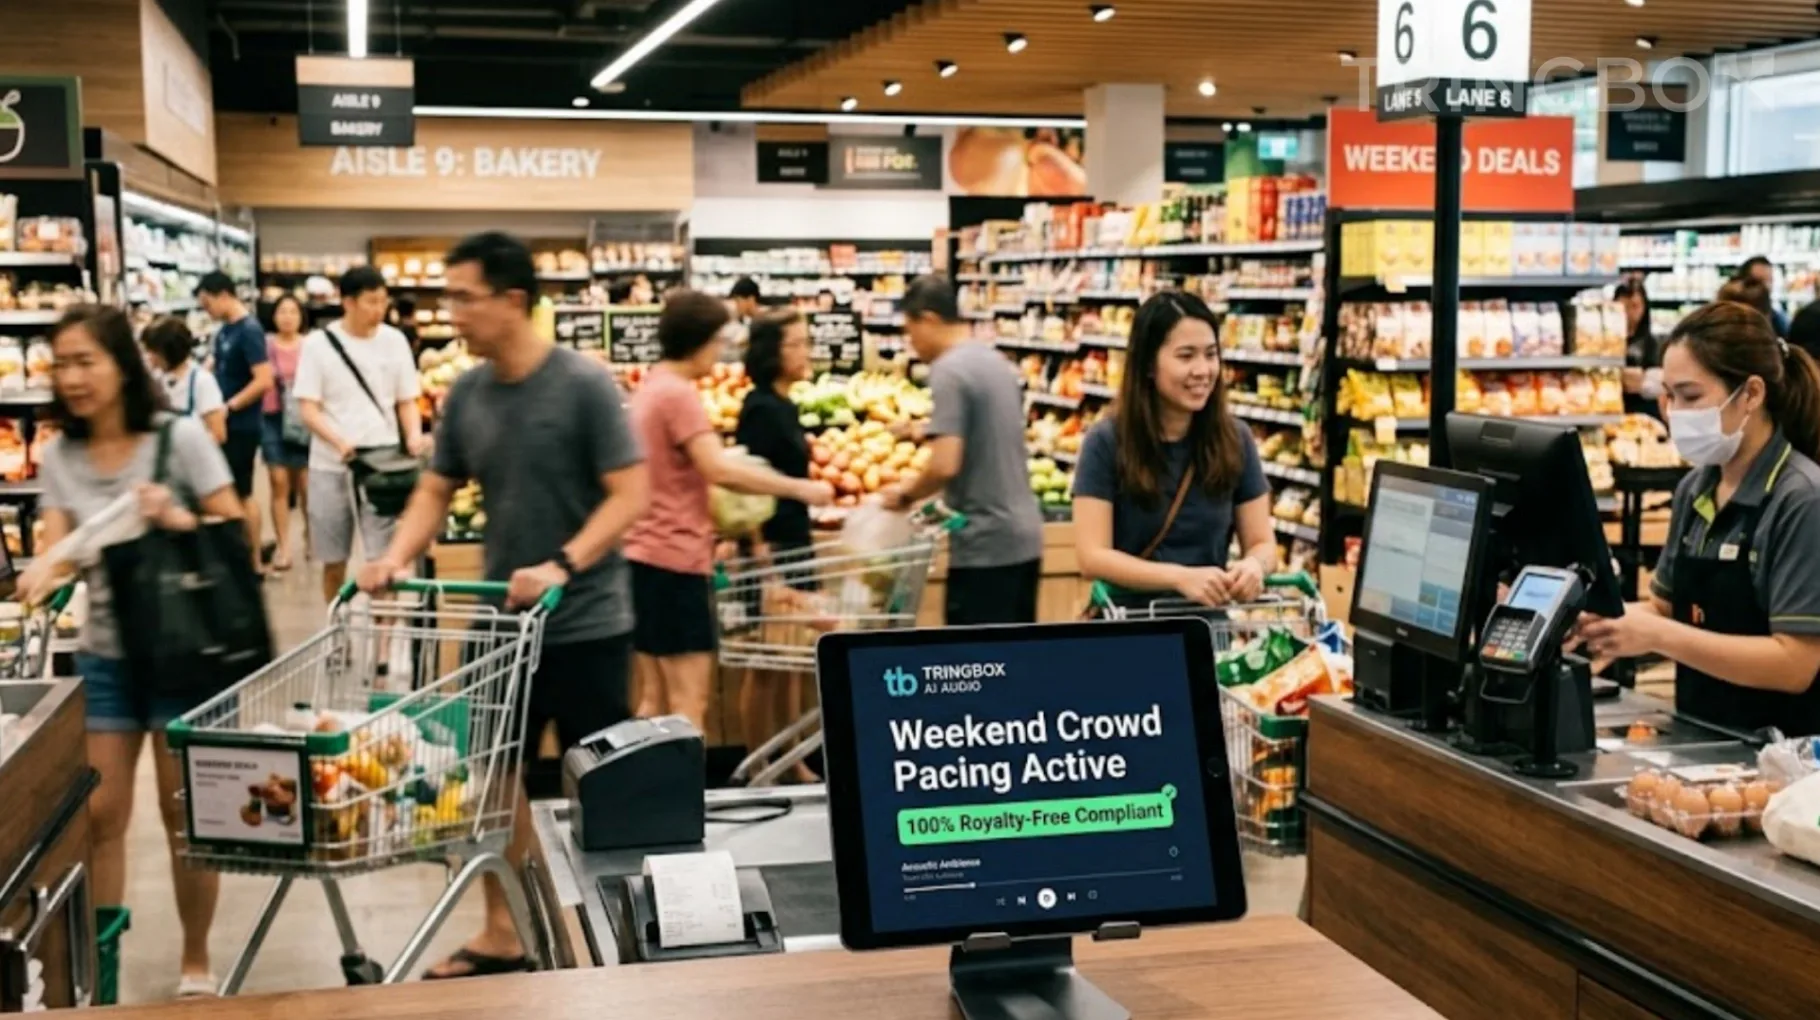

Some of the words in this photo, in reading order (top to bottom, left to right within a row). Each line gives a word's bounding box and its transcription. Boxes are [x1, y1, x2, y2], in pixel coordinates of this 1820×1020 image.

[1395, 2, 1415, 64] 6
[1462, 0, 1498, 61] 6
[1384, 89, 1413, 112] LANE
[1446, 88, 1496, 107] LANE
[1499, 91, 1512, 108] 6
[330, 147, 427, 176] AISLE
[434, 148, 466, 176] 9:
[473, 149, 603, 178] BAKERY
[1343, 144, 1472, 174] WEEKED
[1478, 147, 1562, 175] DEALS
[922, 662, 1006, 680] TRINGBOX
[924, 683, 938, 695] AI
[941, 680, 982, 694] AUDIO
[890, 710, 1048, 751] Weekend
[1056, 703, 1163, 742] Crowd
[894, 756, 1013, 794] Pacing
[1022, 749, 1128, 784] Active
[906, 815, 956, 836] 100%
[960, 807, 1071, 833] Royalty-Free
[1075, 801, 1164, 825] Compliant
